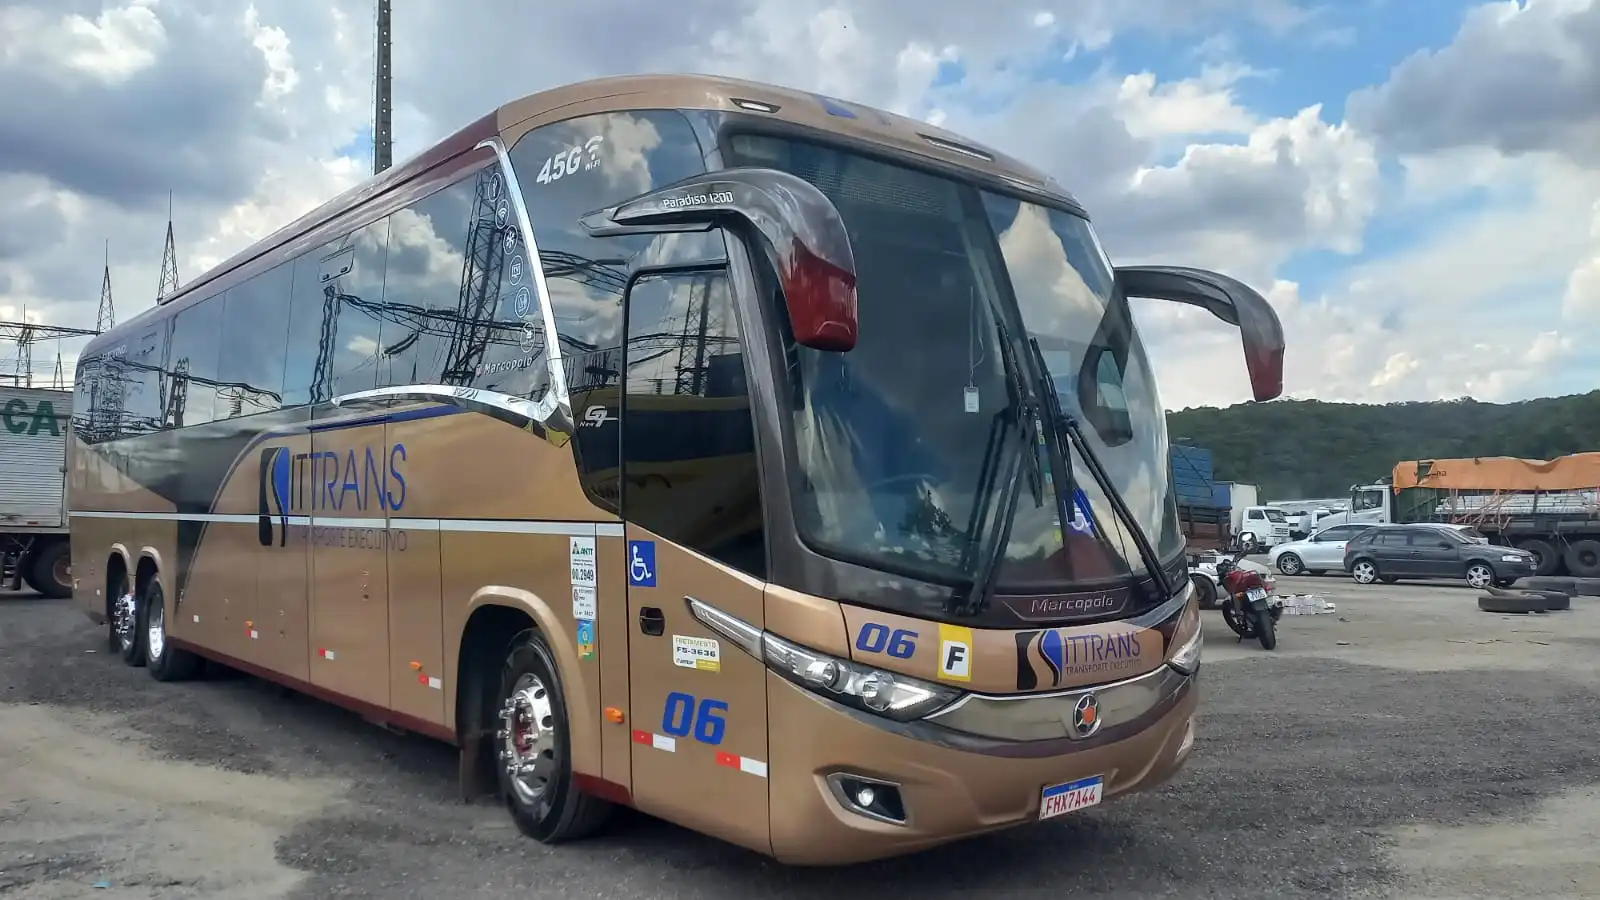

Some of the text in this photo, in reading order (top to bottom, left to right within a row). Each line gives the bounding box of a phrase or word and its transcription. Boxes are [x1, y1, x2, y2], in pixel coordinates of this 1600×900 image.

[662, 191, 734, 209] Paradiso 1200
[483, 356, 533, 376] Marcopolo
[3, 398, 61, 436] CA
[1031, 594, 1114, 613] Marcopolo
[855, 622, 919, 660] 06
[945, 645, 966, 671] F
[1064, 662, 1109, 676] TRANSPORTE
[662, 692, 729, 745] 06
[1045, 786, 1096, 816] FHX7A44
